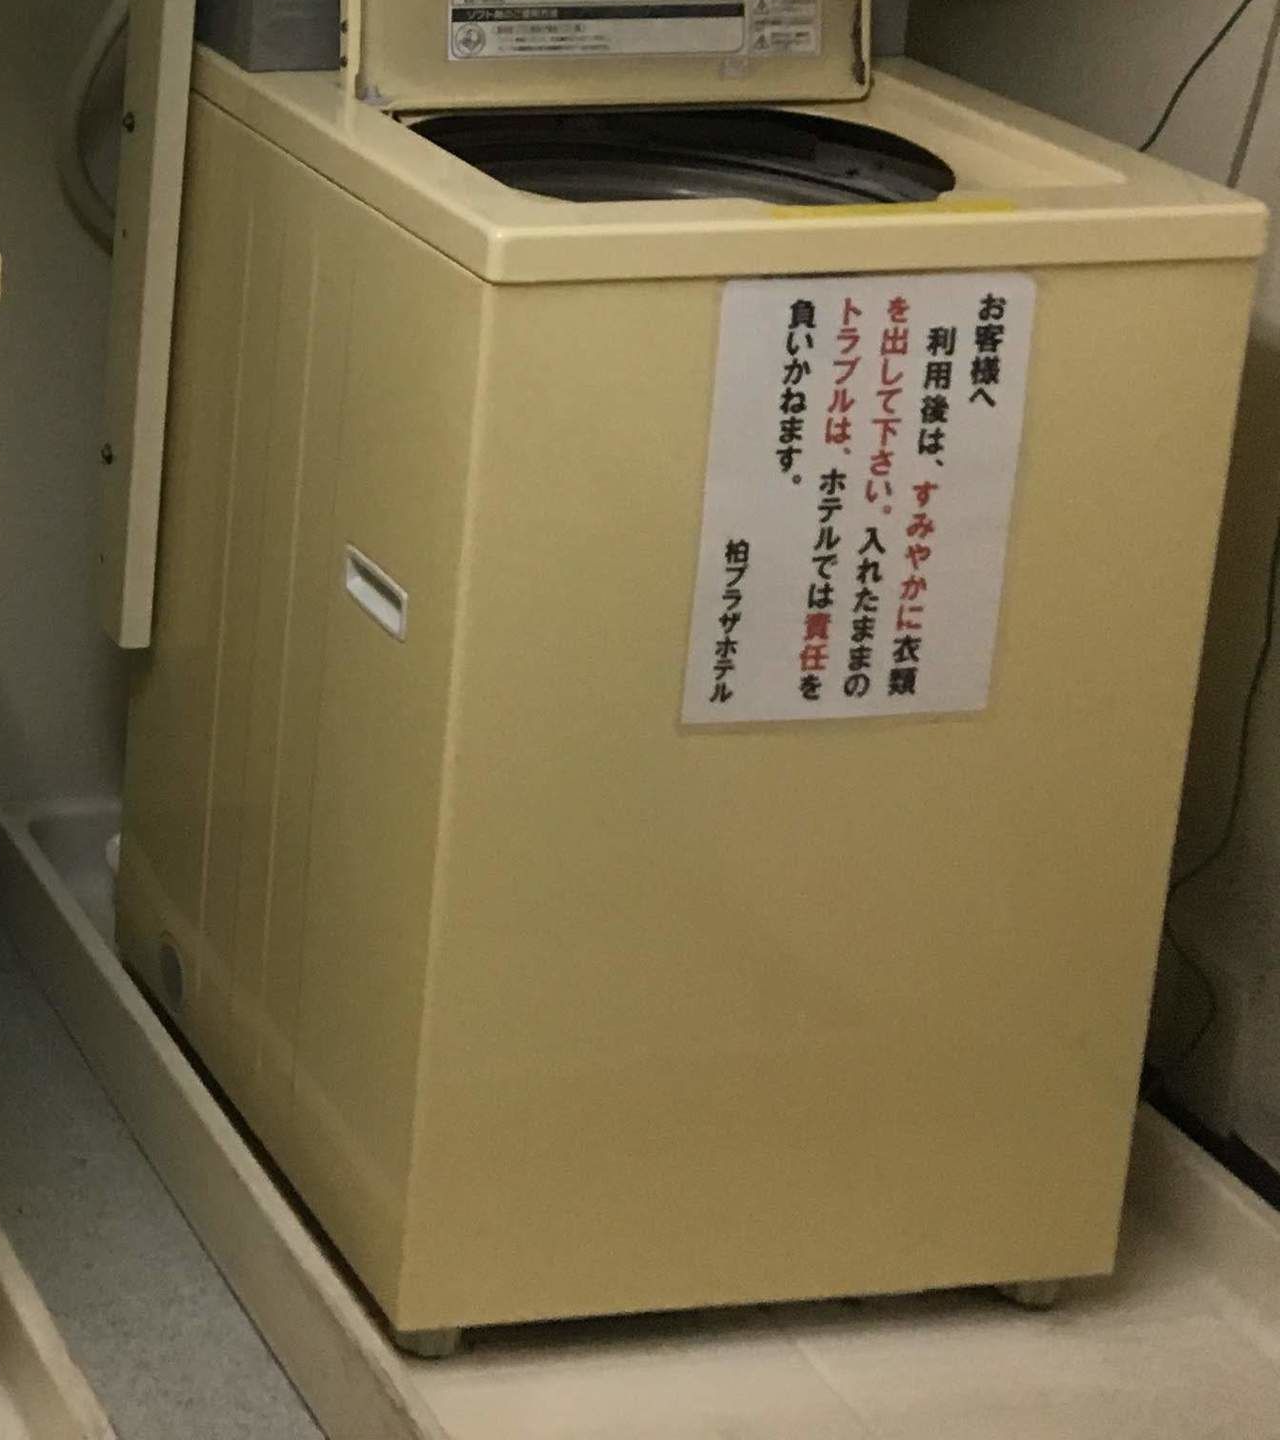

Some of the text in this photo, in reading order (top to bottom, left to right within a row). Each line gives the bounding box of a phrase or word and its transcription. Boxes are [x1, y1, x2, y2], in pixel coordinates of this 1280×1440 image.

[776, 299, 817, 486] 負いかねます。
[969, 293, 1007, 409] お客様へ
[709, 539, 751, 705] 柏プラザホテル
